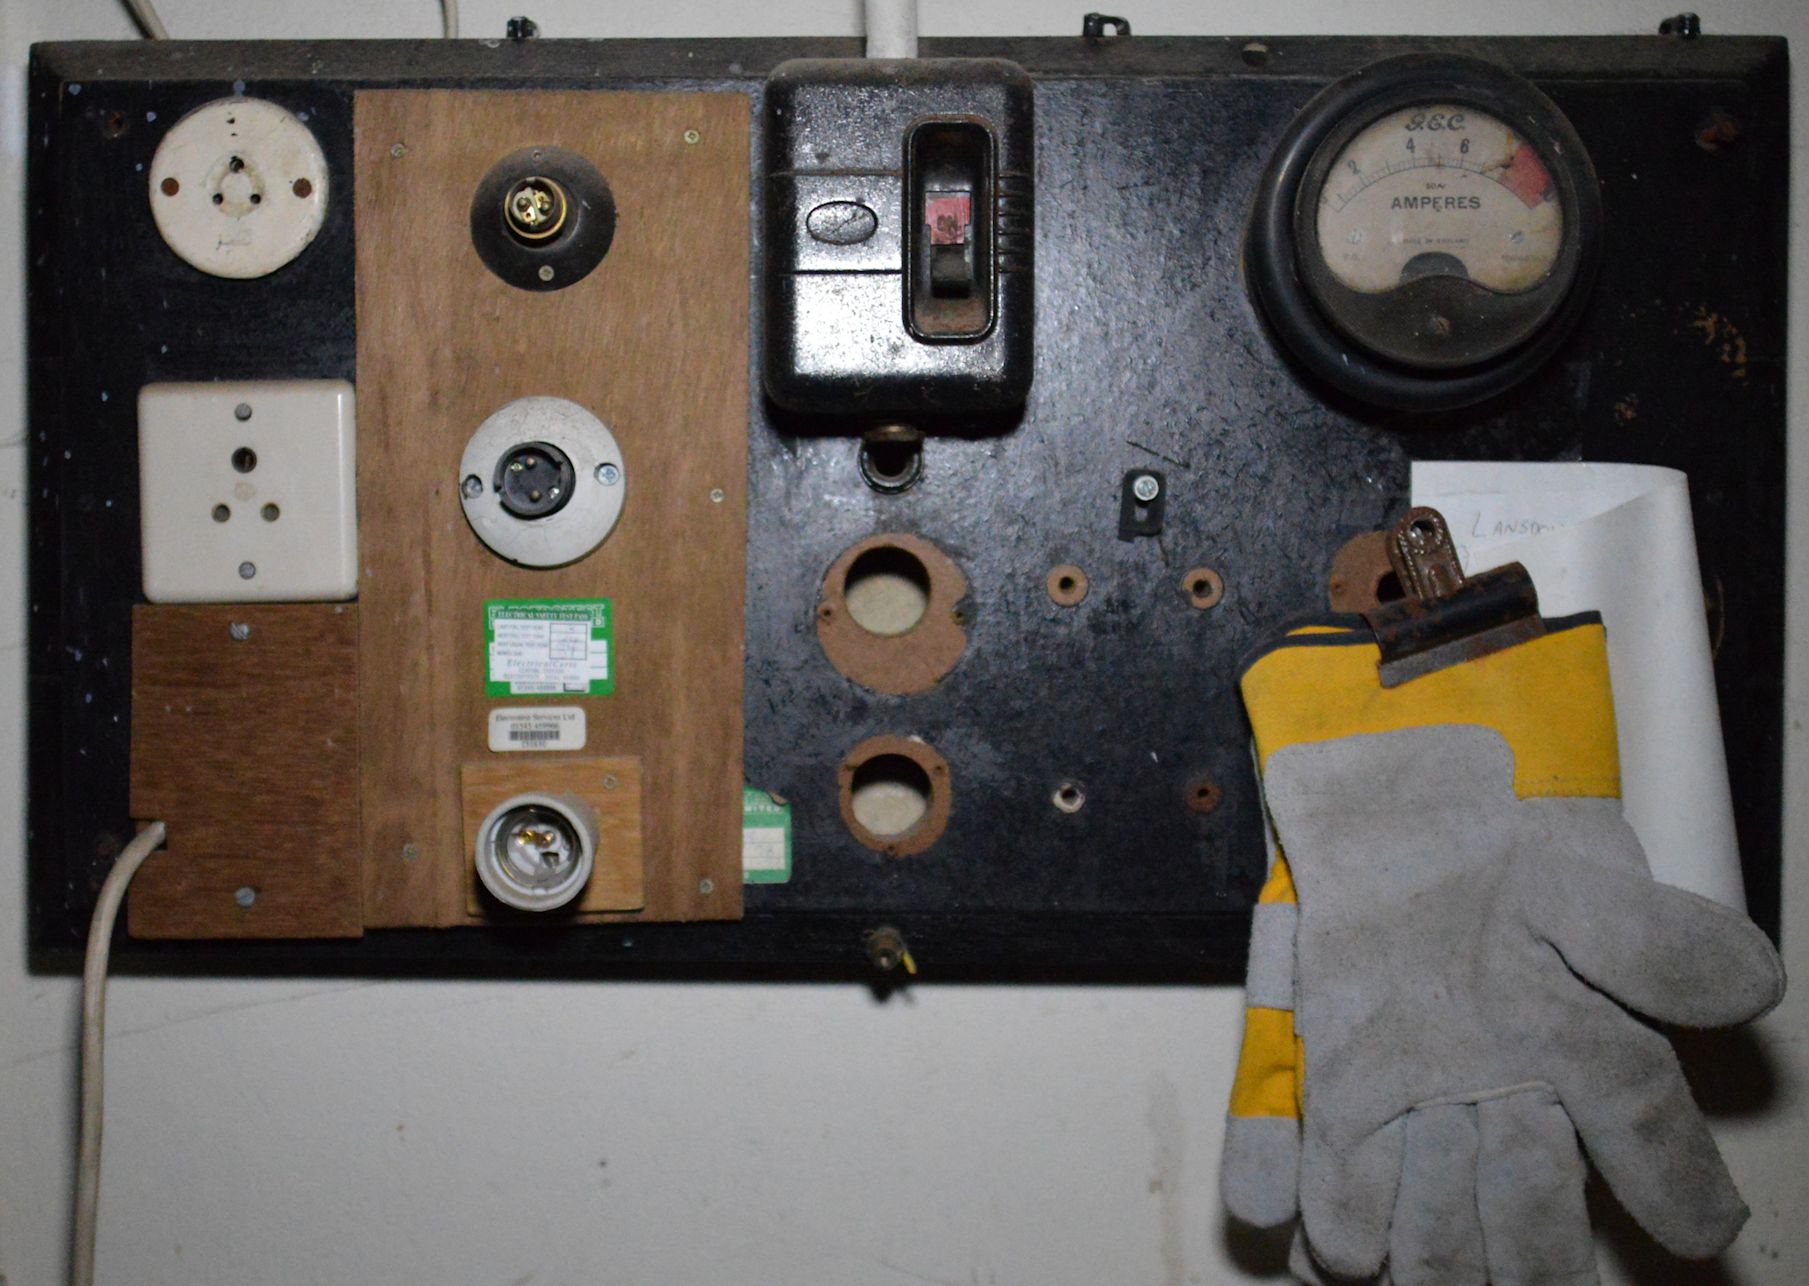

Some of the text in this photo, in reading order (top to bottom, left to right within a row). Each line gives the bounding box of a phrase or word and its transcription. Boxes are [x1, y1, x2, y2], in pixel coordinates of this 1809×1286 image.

[1347, 138, 1471, 175] 2 4 6
[1391, 196, 1481, 210] AMPERES
